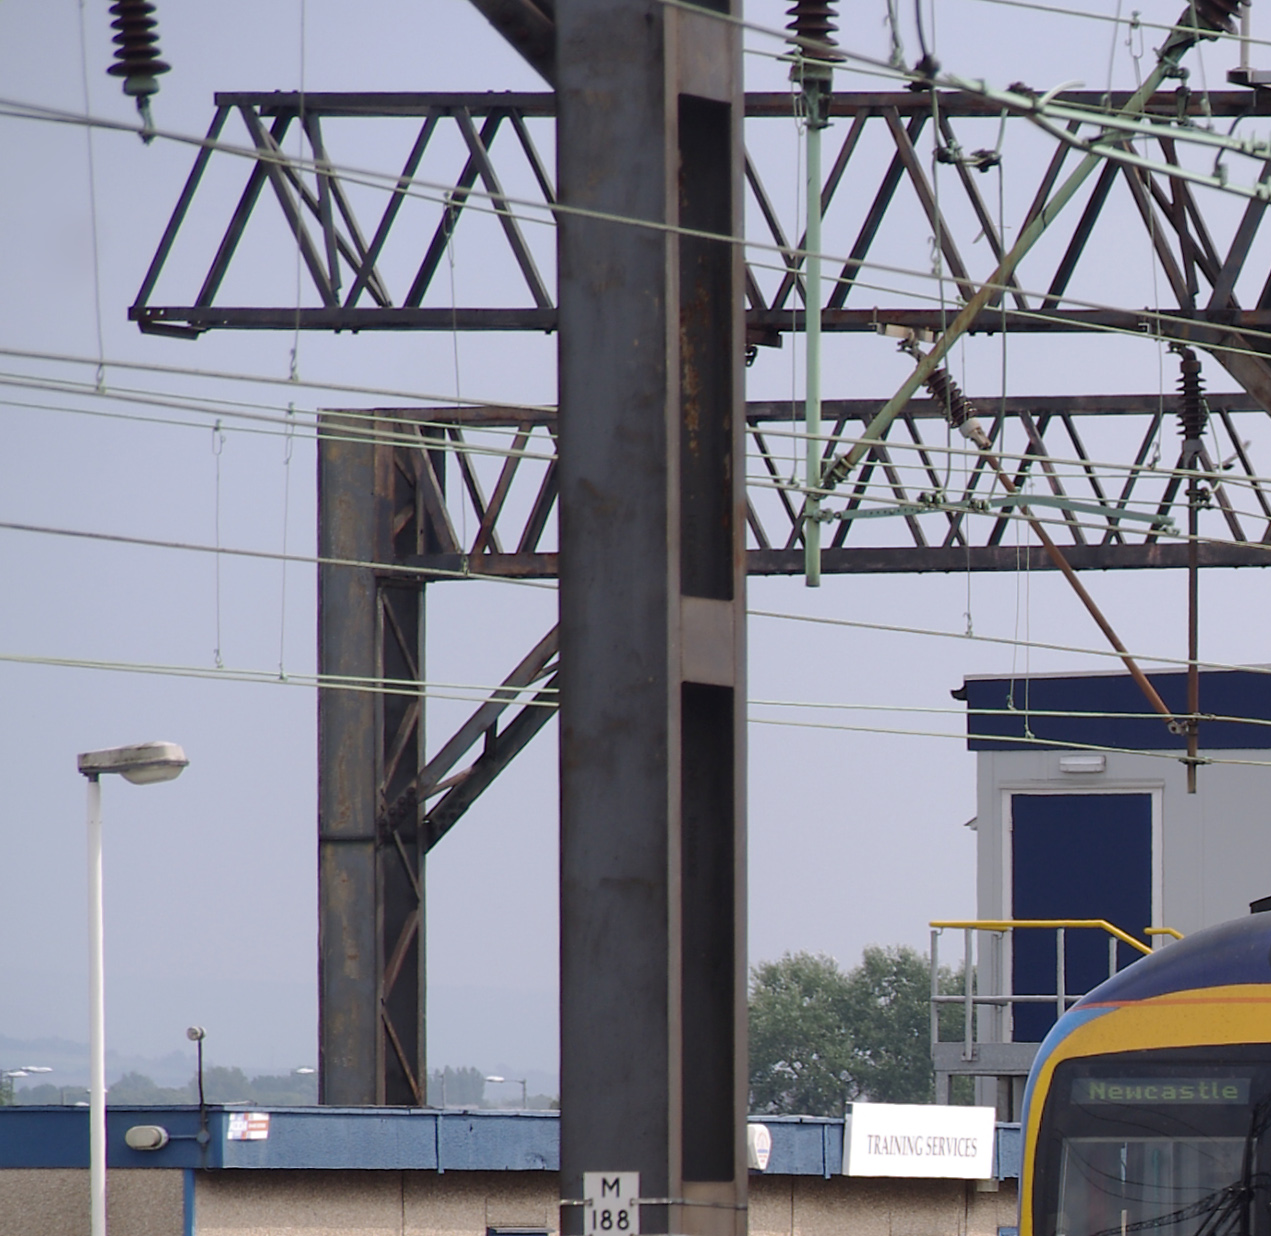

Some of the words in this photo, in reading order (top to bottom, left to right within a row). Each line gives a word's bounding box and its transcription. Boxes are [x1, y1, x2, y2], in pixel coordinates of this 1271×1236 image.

[1088, 1081, 1239, 1100] Newcastle
[866, 1133, 924, 1156] TRAINING
[925, 1135, 979, 1158] SERVICES
[601, 1176, 621, 1198] M
[592, 1208, 630, 1231] 188
